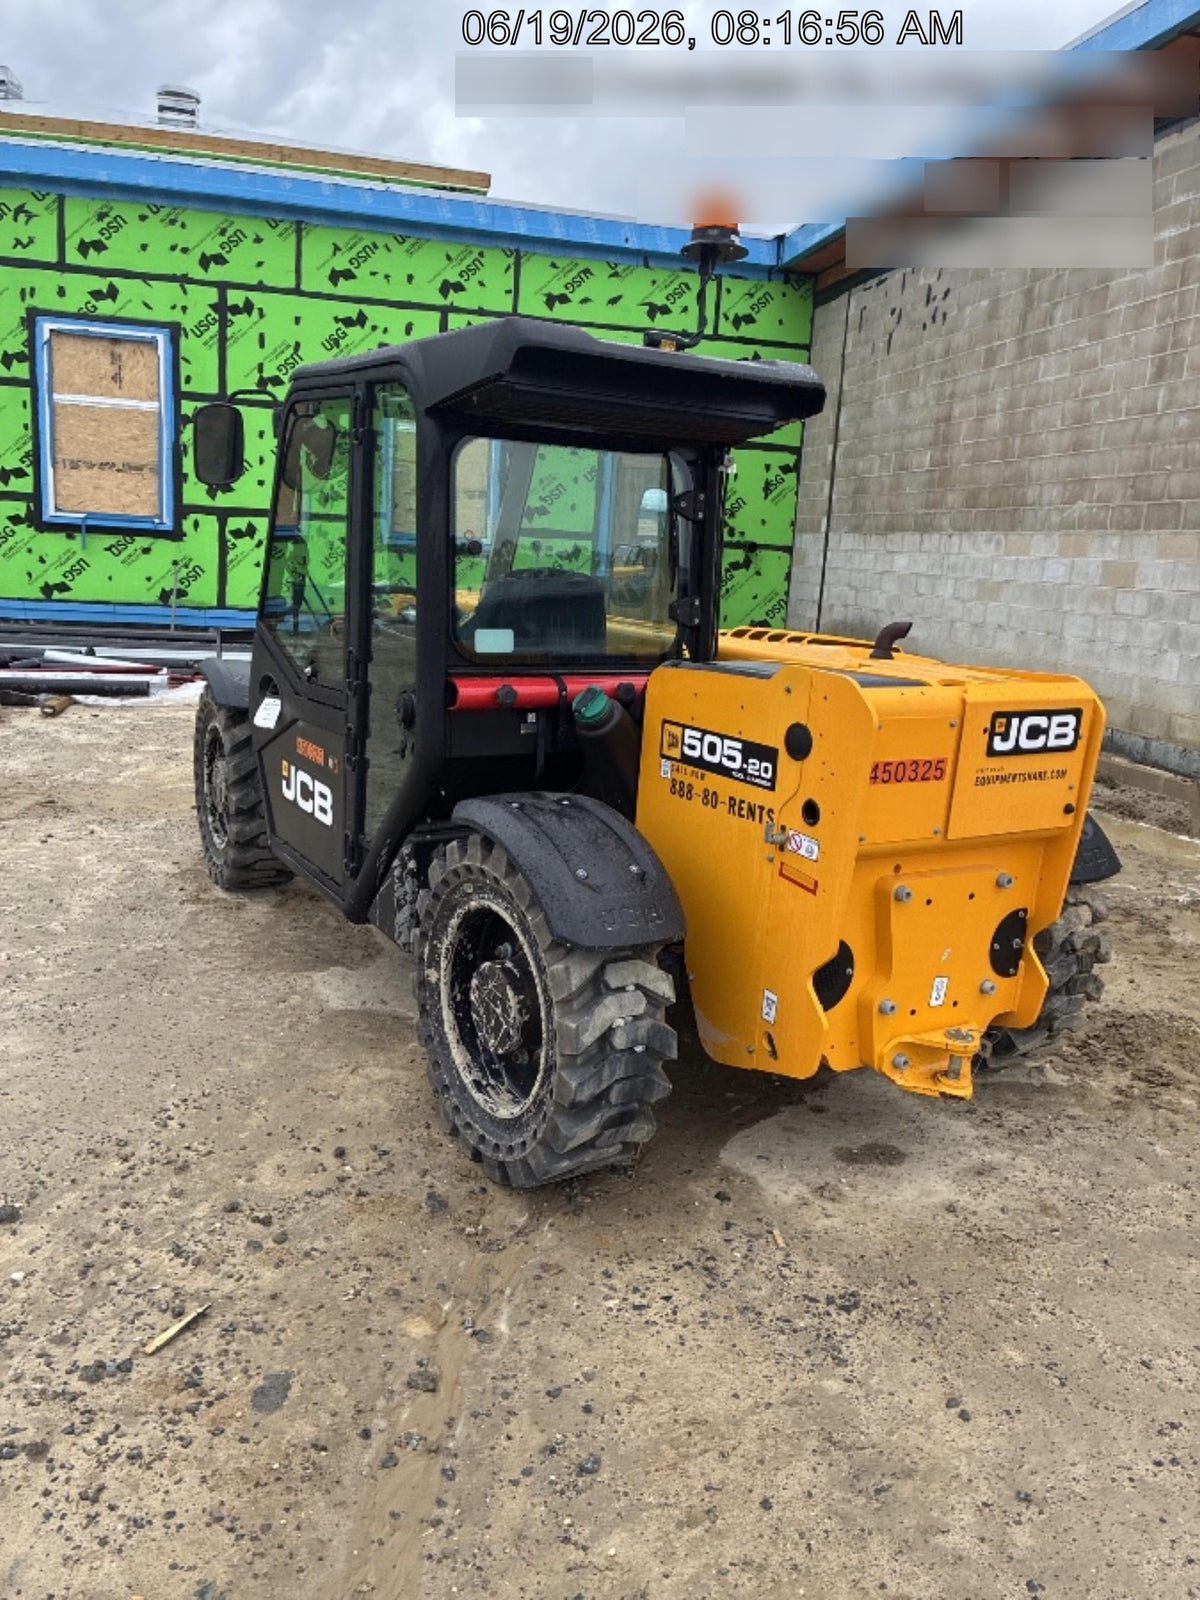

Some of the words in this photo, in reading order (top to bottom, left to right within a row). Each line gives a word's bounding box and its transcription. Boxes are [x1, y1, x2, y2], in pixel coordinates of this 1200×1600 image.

[98, 214, 128, 241] USG
[219, 228, 248, 255] USG
[349, 241, 379, 270] USG
[458, 257, 485, 282] USG
[564, 267, 595, 294] USG
[665, 282, 692, 305] USG
[750, 291, 775, 314] USG
[189, 313, 219, 339] USG
[321, 327, 349, 351] USG
[276, 351, 304, 376] USG
[541, 482, 567, 506] USG
[0, 525, 16, 547] SG
[62, 557, 91, 582] USG
[179, 564, 206, 589] USG
[993, 714, 1077, 751] JCB
[870, 760, 945, 784] 450325
[282, 764, 333, 826] JCB
[670, 778, 775, 825] 888-80-RENTS
